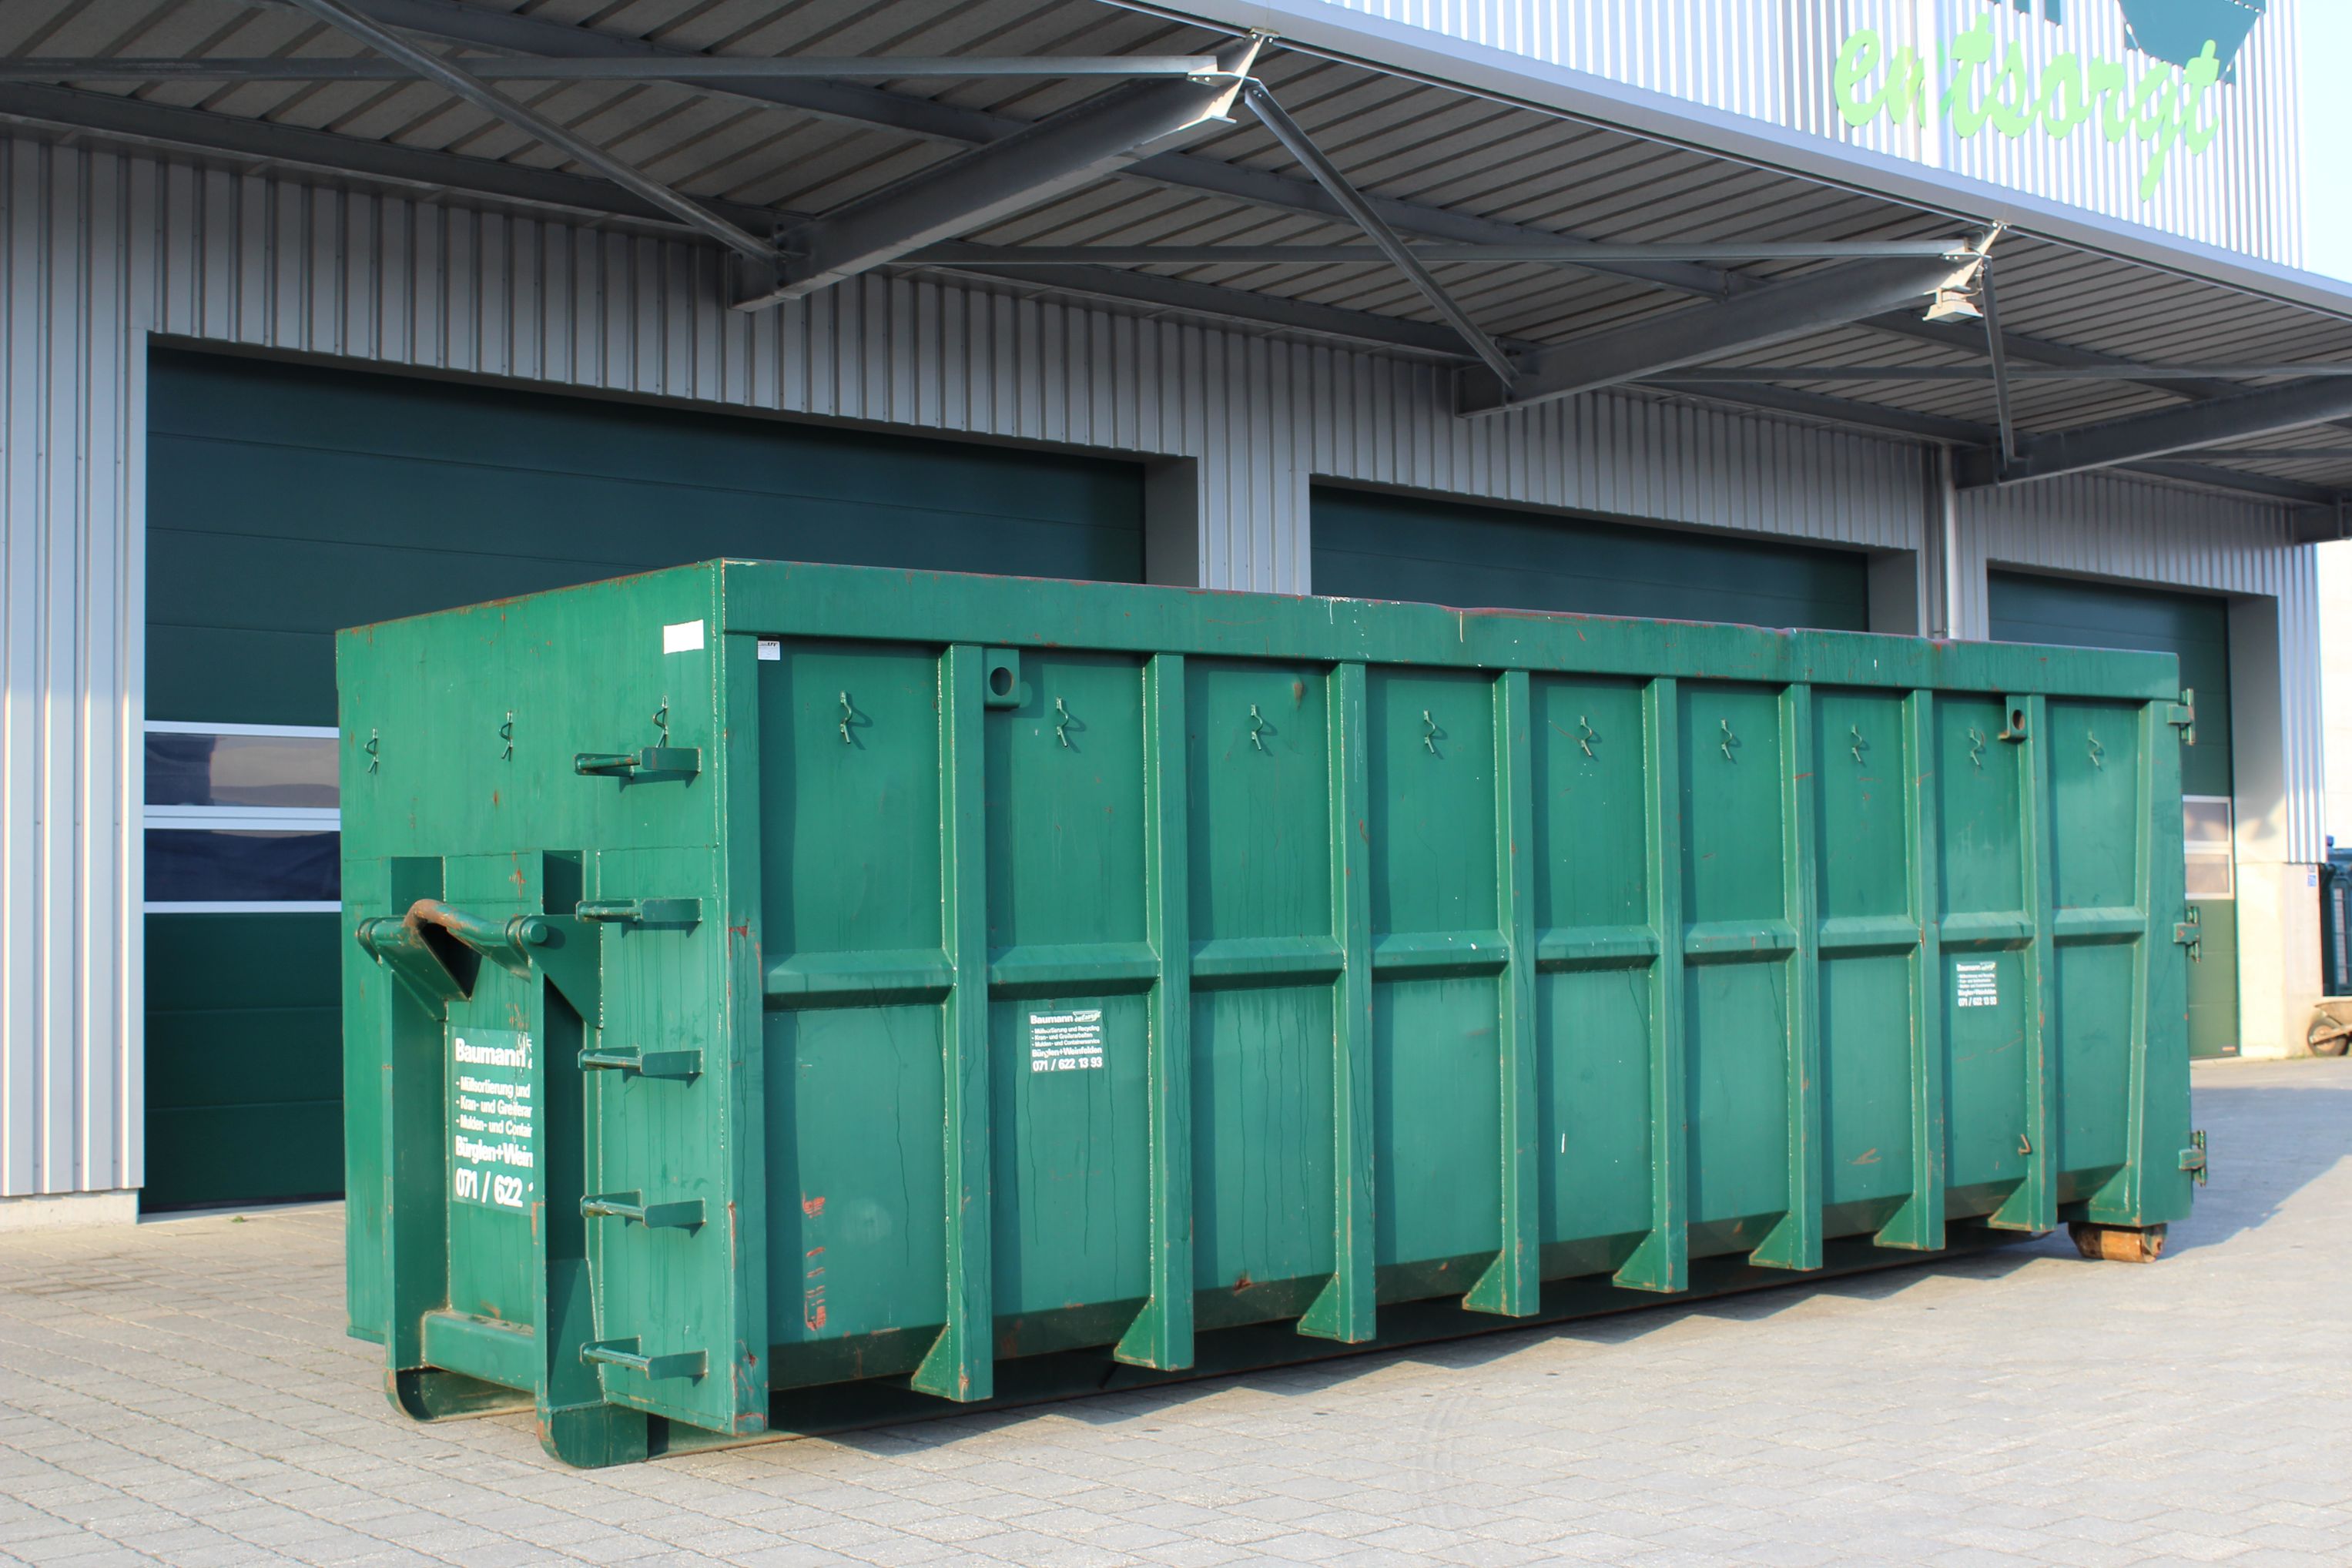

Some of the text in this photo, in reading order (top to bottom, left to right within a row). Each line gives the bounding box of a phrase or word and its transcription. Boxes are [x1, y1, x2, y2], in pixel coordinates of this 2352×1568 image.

[1834, 12, 2220, 202] entsorgt
[1030, 1015, 1073, 1024] Baumann
[455, 1037, 525, 1068] Baumann
[1033, 1057, 1102, 1071] 071 / 622 13 93
[460, 1076, 530, 1099] Müllsortierung und
[481, 1099, 496, 1114] und
[488, 1118, 504, 1134] und
[455, 1168, 524, 1208] 071 / 622
